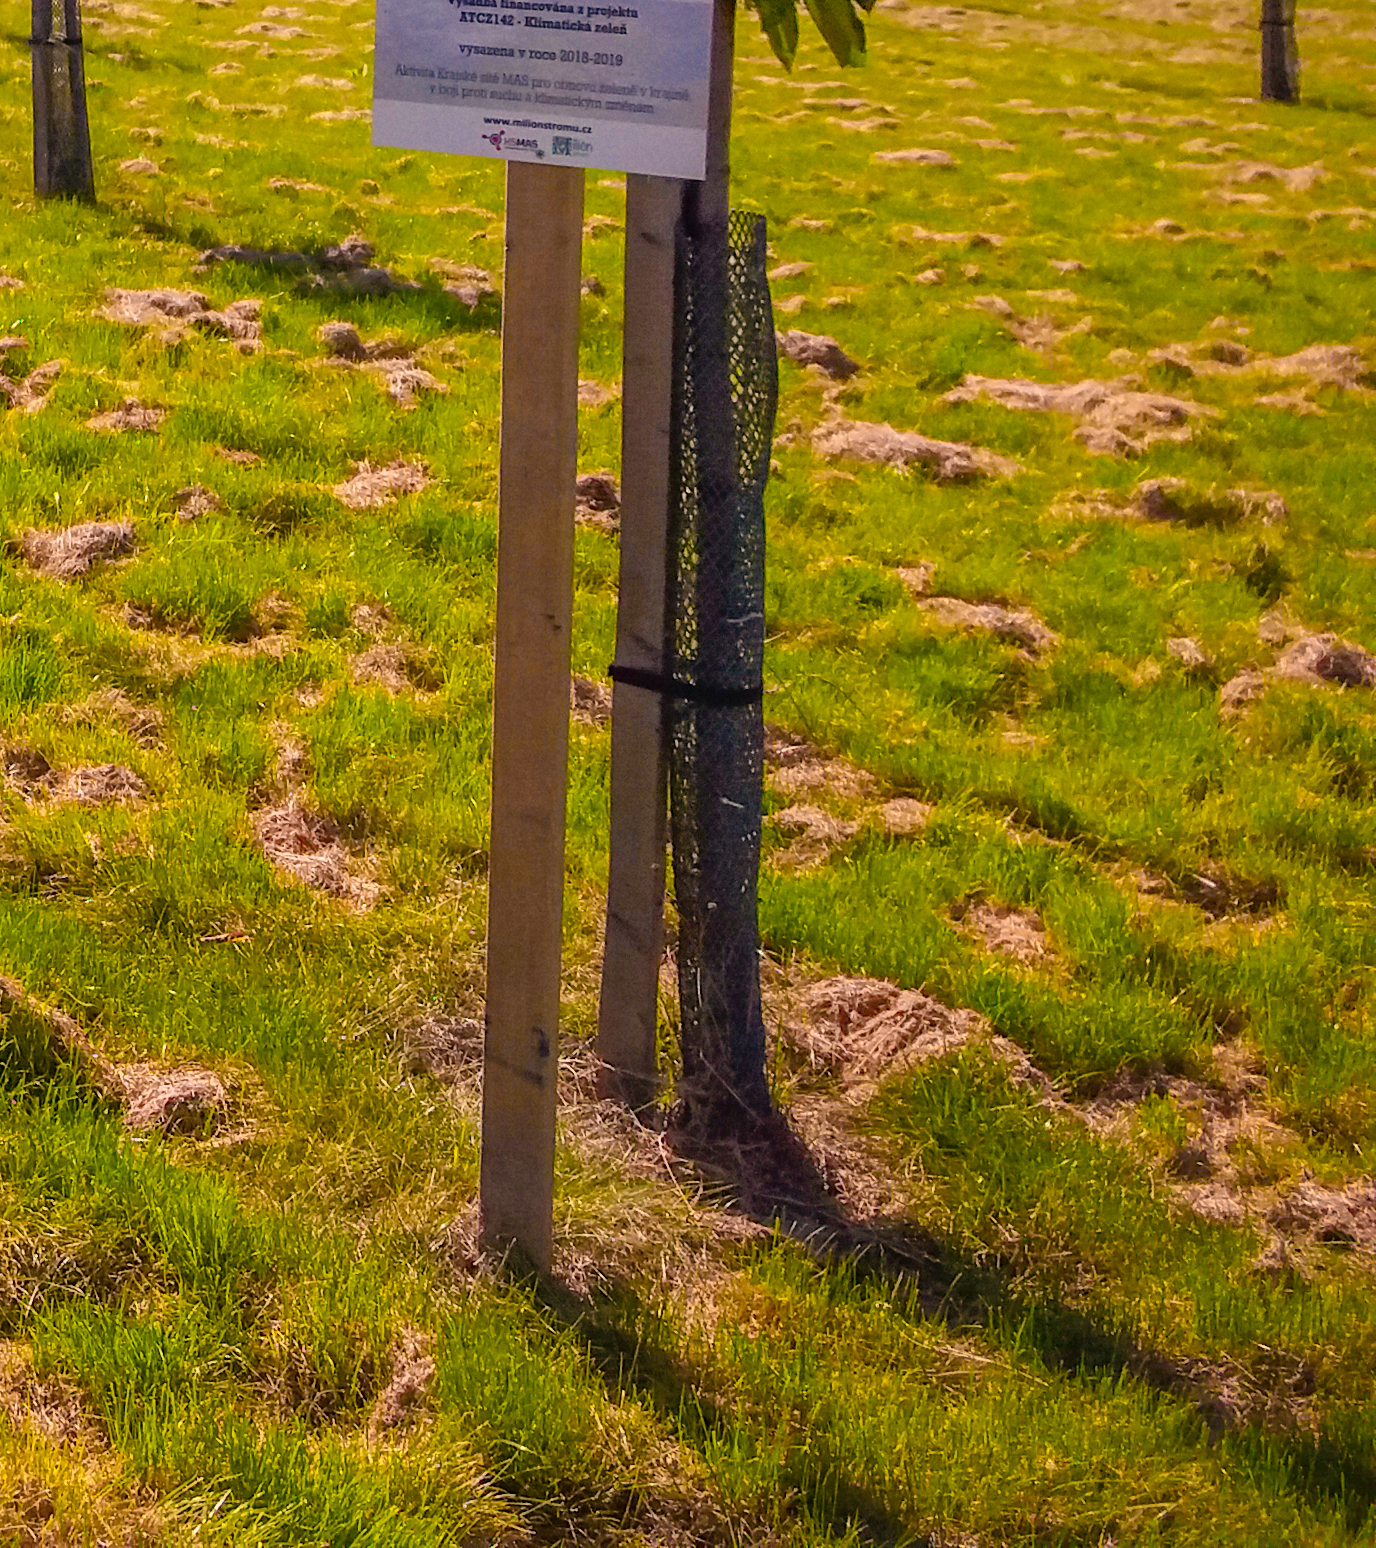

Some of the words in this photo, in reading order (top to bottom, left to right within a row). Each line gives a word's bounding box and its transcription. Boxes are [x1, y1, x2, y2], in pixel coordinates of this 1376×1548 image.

[577, 5, 584, 14] z
[587, 4, 639, 19] projektu
[459, 11, 514, 26] ATCZ142
[524, 15, 592, 32] Klimatická
[595, 22, 627, 35] zeleň
[459, 44, 514, 59] vysazena
[518, 49, 526, 58] v
[529, 49, 556, 61] roce
[560, 49, 623, 67] 2018-2019
[502, 71, 529, 87] MAS
[531, 78, 551, 90] pro
[461, 86, 487, 100] proti
